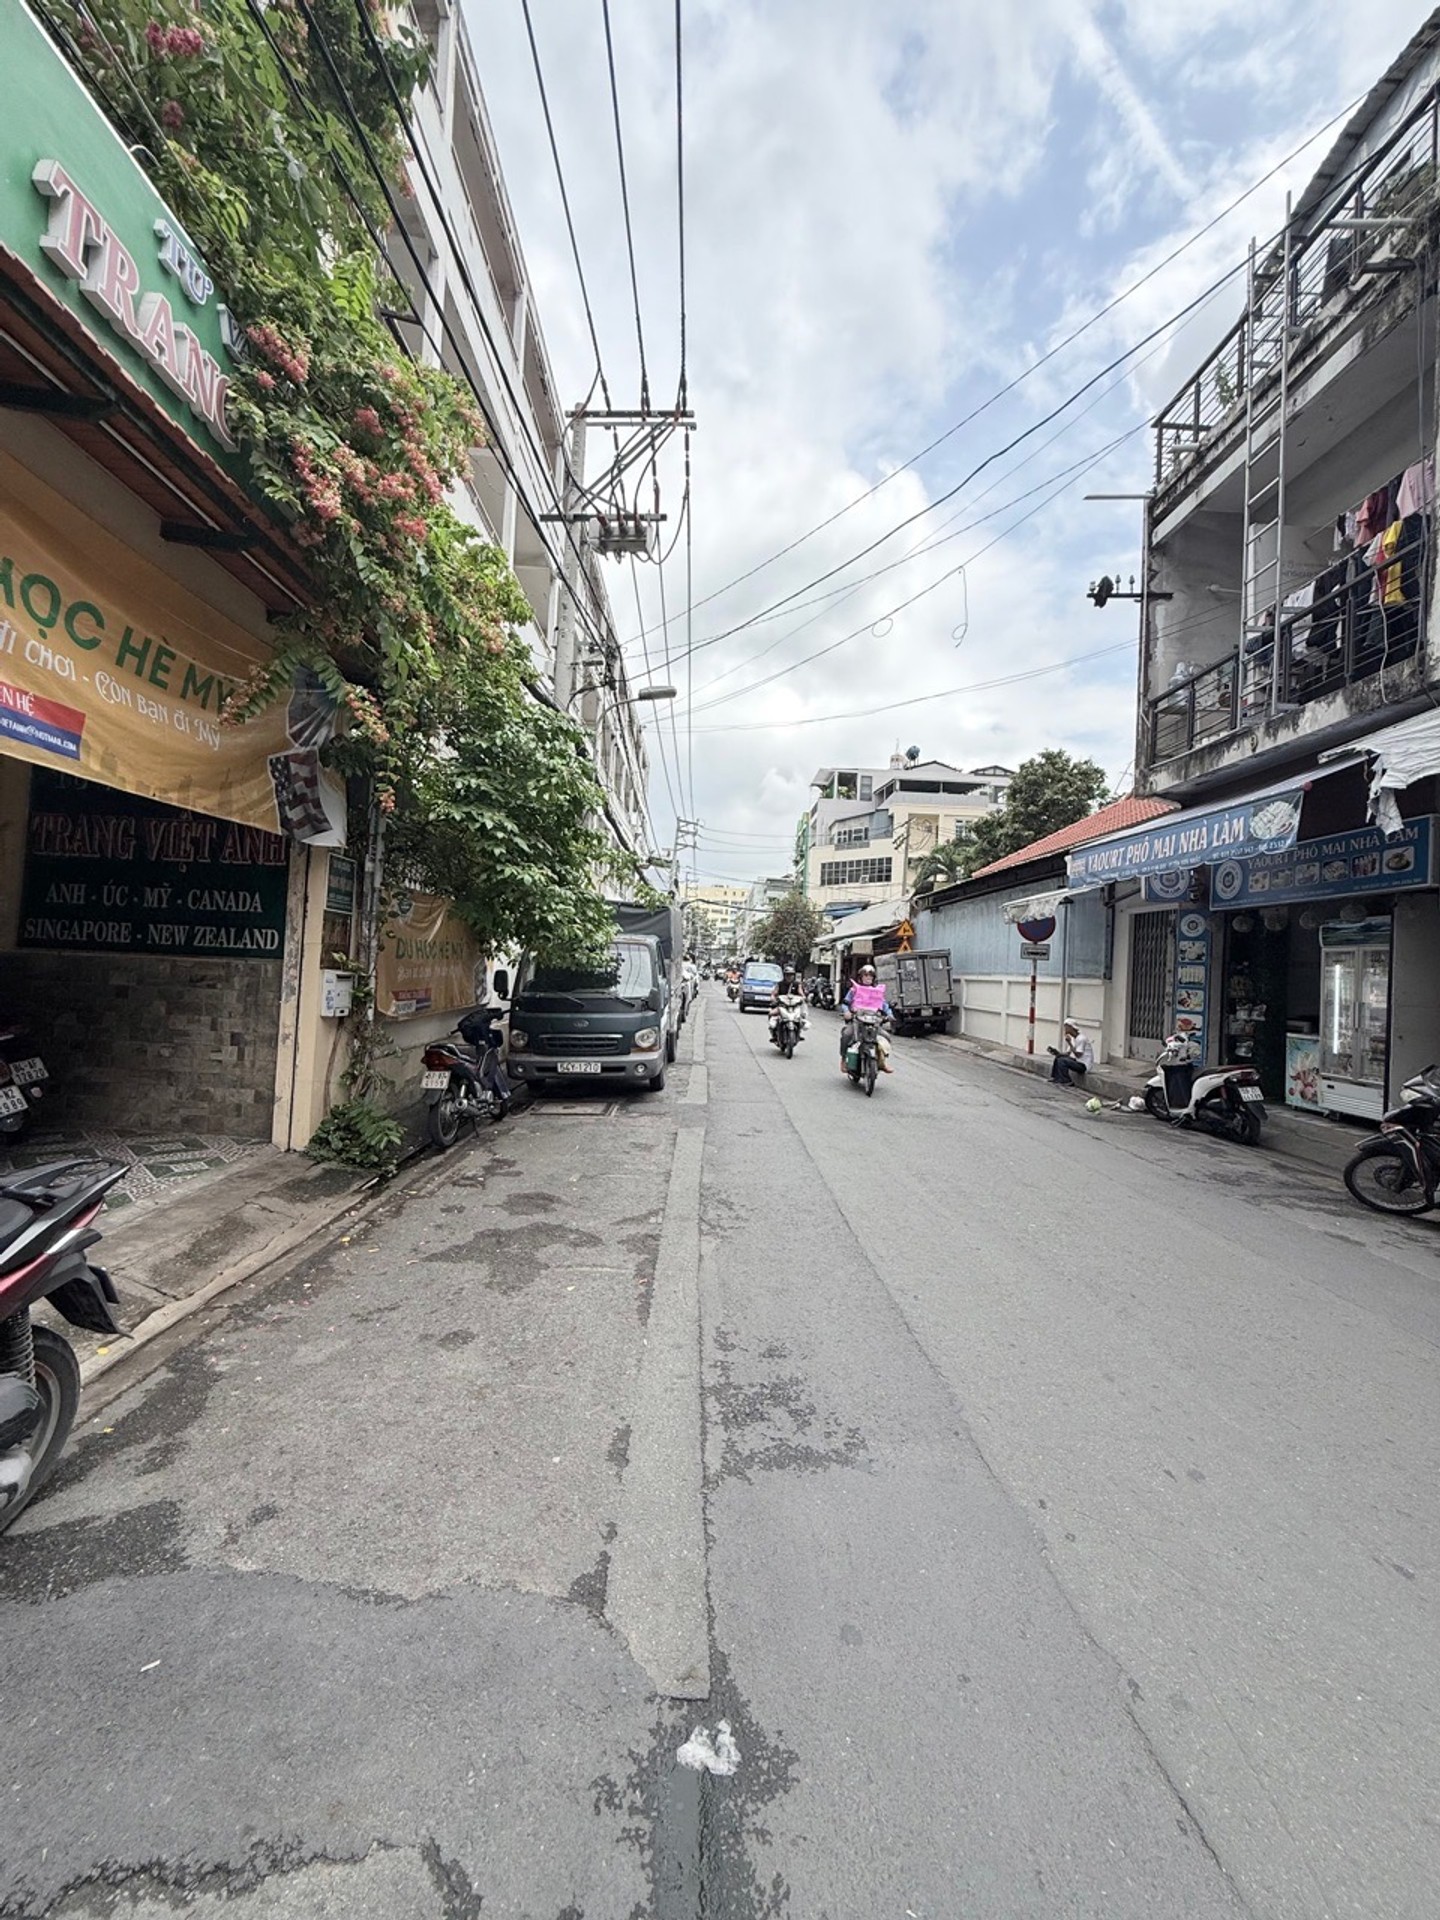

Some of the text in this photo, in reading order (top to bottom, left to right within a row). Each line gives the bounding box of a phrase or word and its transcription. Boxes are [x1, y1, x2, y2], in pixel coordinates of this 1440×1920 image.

[32, 810, 287, 872] TRANG VIỆT ANH
[1088, 847, 1125, 872] YAOURT
[1151, 834, 1176, 860] MAI
[1179, 819, 1208, 854] NHÀ
[1211, 813, 1245, 847] LÀM
[1248, 853, 1290, 869] YAOURT
[1321, 840, 1346, 856] MAI
[1350, 831, 1380, 851] NHÀ
[45, 880, 263, 912] ANH ÚC MỸ CANADA
[24, 918, 279, 949] SINGAPORE NEW ZEALAND
